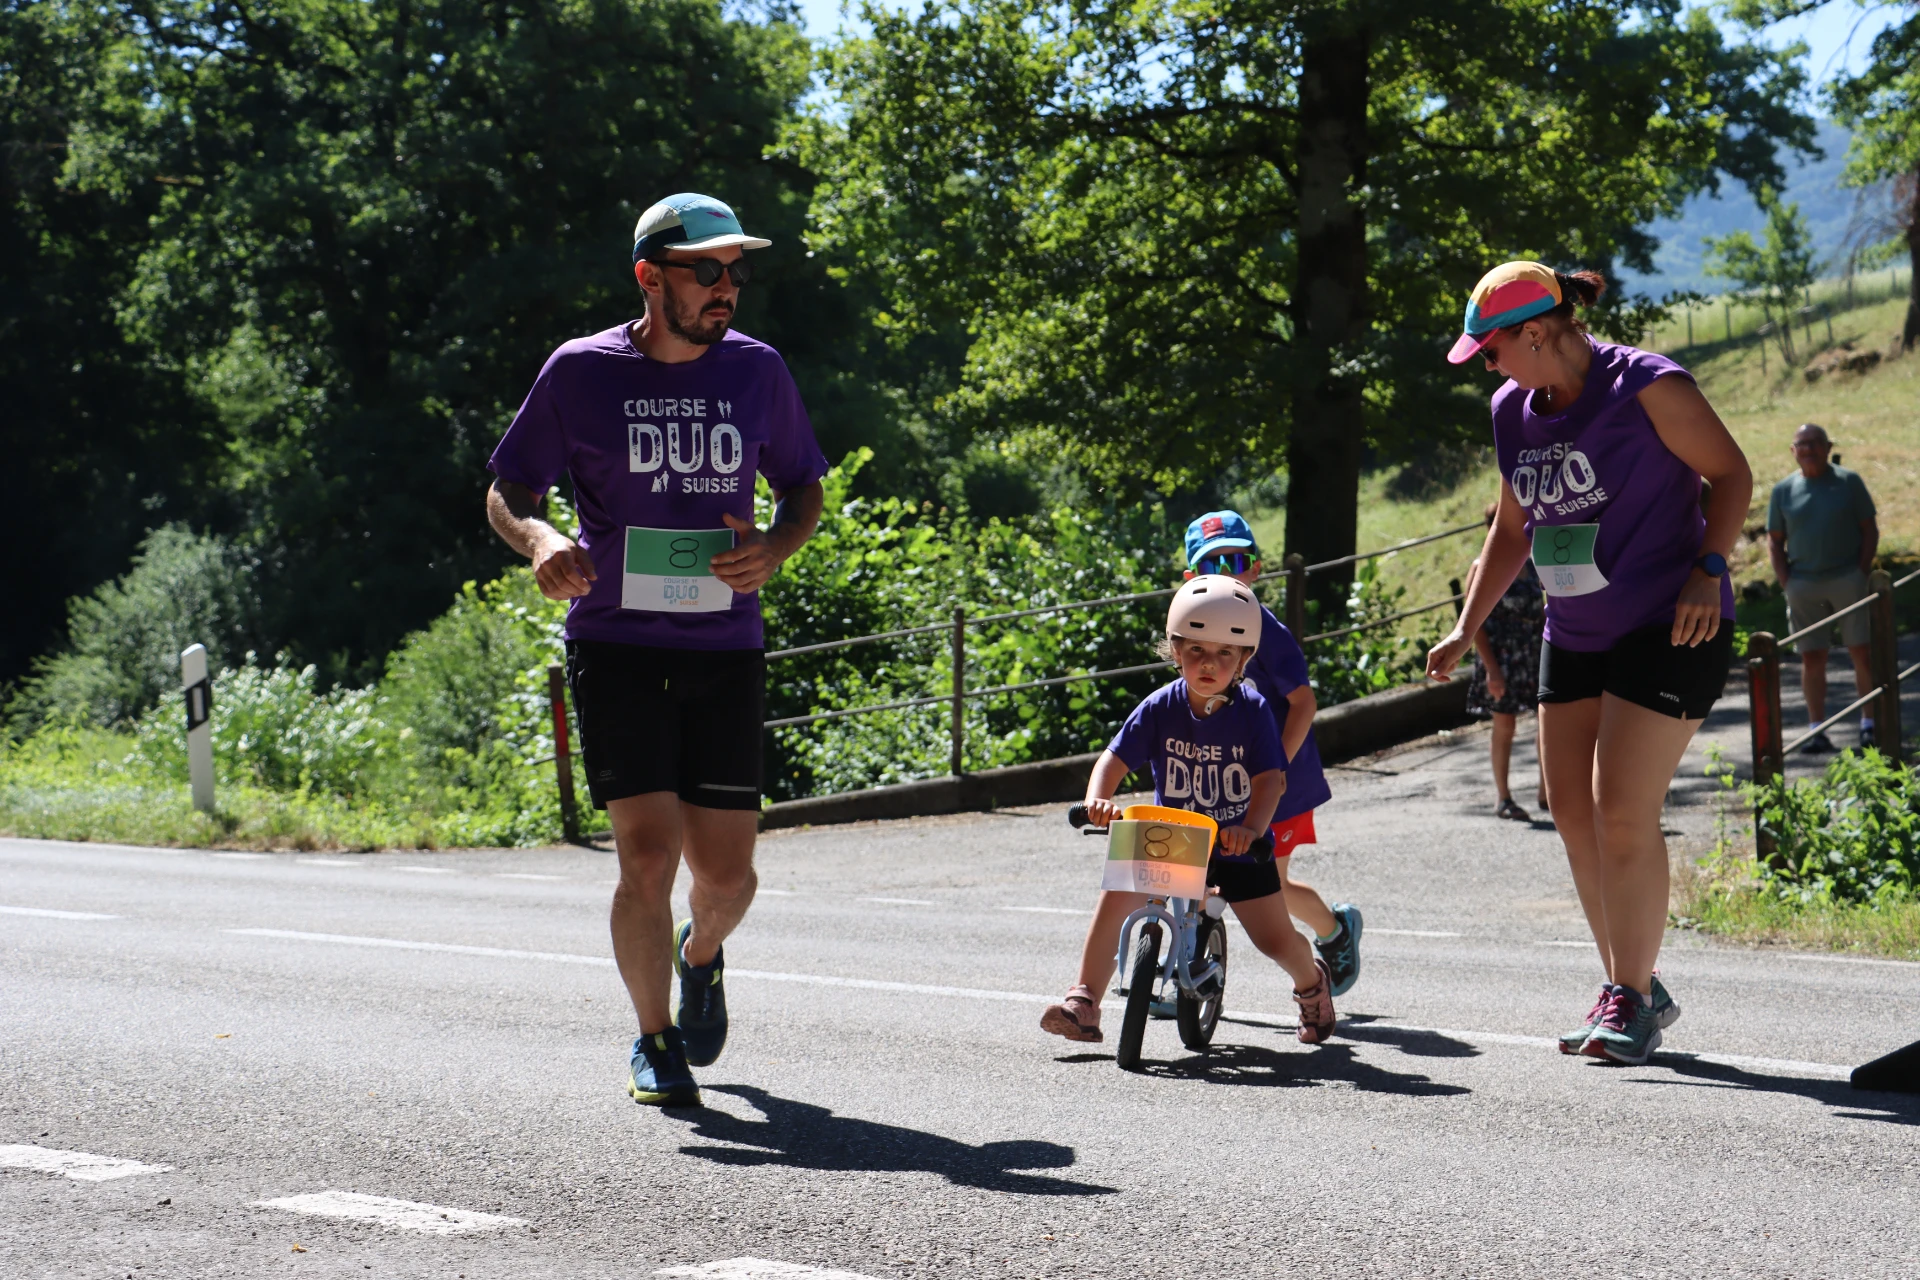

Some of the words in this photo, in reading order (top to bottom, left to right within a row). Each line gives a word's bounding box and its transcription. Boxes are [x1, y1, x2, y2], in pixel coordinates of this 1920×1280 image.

[624, 398, 707, 417] COURSE
[628, 422, 742, 474] DUO
[682, 477, 739, 494] SUISSE
[1512, 450, 1596, 507] DUO
[1554, 487, 1608, 515] SUISSE
[669, 537, 700, 569] 8
[1553, 529, 1573, 564] 8
[663, 585, 699, 600] DUO
[1554, 572, 1575, 586] DUO
[1166, 737, 1222, 762] COURSE
[1164, 757, 1252, 808] DUO
[1144, 825, 1173, 859] 8
[1138, 868, 1171, 885] DUO
